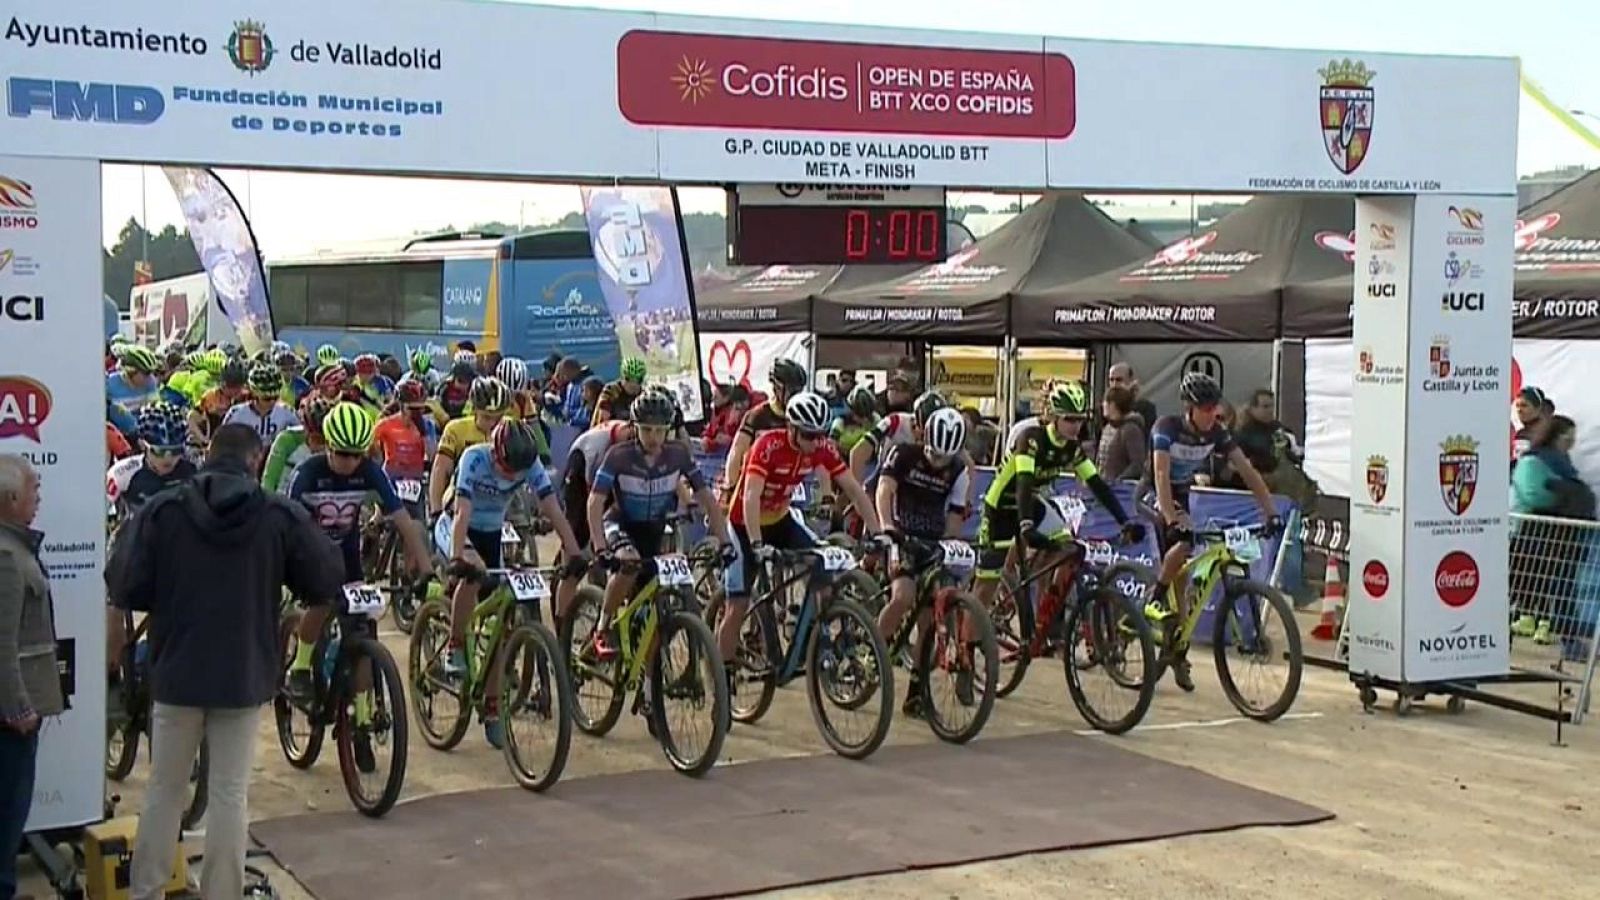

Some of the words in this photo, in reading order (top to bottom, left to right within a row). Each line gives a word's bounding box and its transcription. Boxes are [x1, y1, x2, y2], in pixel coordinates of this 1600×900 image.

[5, 16, 207, 55] Ayuntamiento
[290, 40, 320, 62] de
[327, 43, 442, 71] Valladolid
[722, 61, 848, 100] Cofidis
[870, 66, 924, 88] OPEN
[930, 70, 955, 88] DE
[960, 69, 1034, 92] ESPAÑA
[6, 76, 166, 125] FMD
[173, 85, 307, 108] Fundación
[318, 94, 443, 115] Municipal
[870, 91, 904, 111] BTT
[909, 93, 949, 112] XCO
[956, 95, 1034, 115] COFIDIS
[231, 114, 263, 131] de
[272, 118, 402, 137] Deportes
[725, 139, 757, 156] G.P.
[763, 139, 824, 157] CIUDAD
[829, 142, 851, 158] DE
[855, 142, 954, 160] VALLADOLID
[960, 145, 989, 161] BTT
[806, 161, 850, 178] META
[865, 163, 915, 179] FINISH
[1249, 178, 1302, 190] FEDERACIÓN
[1305, 180, 1316, 190] DE
[1318, 180, 1357, 191] CICLISMO
[1359, 180, 1370, 190] DE
[1371, 180, 1409, 191] CASTILLA
[1411, 181, 1417, 191] Y
[1418, 179, 1441, 191] LEÓN
[847, 209, 938, 257] 0:00
[1446, 236, 1485, 246] CICLISMO
[1450, 293, 1484, 311] UCI
[1544, 300, 1598, 317] ROTOR
[845, 309, 882, 321] PRIMAFLOR
[938, 307, 964, 321] ROTOR
[1055, 309, 1105, 323] PRIMAFLOR
[1113, 307, 1172, 322] MONDRAKER
[1181, 306, 1215, 321] ROTOR
[1454, 366, 1482, 377] Junta
[1485, 365, 1499, 376] de
[1423, 380, 1461, 391] Castilla
[1463, 382, 1470, 393] y
[1473, 379, 1499, 391] León
[514, 574, 544, 591] 303
[1419, 634, 1496, 653] NOVOTEL
